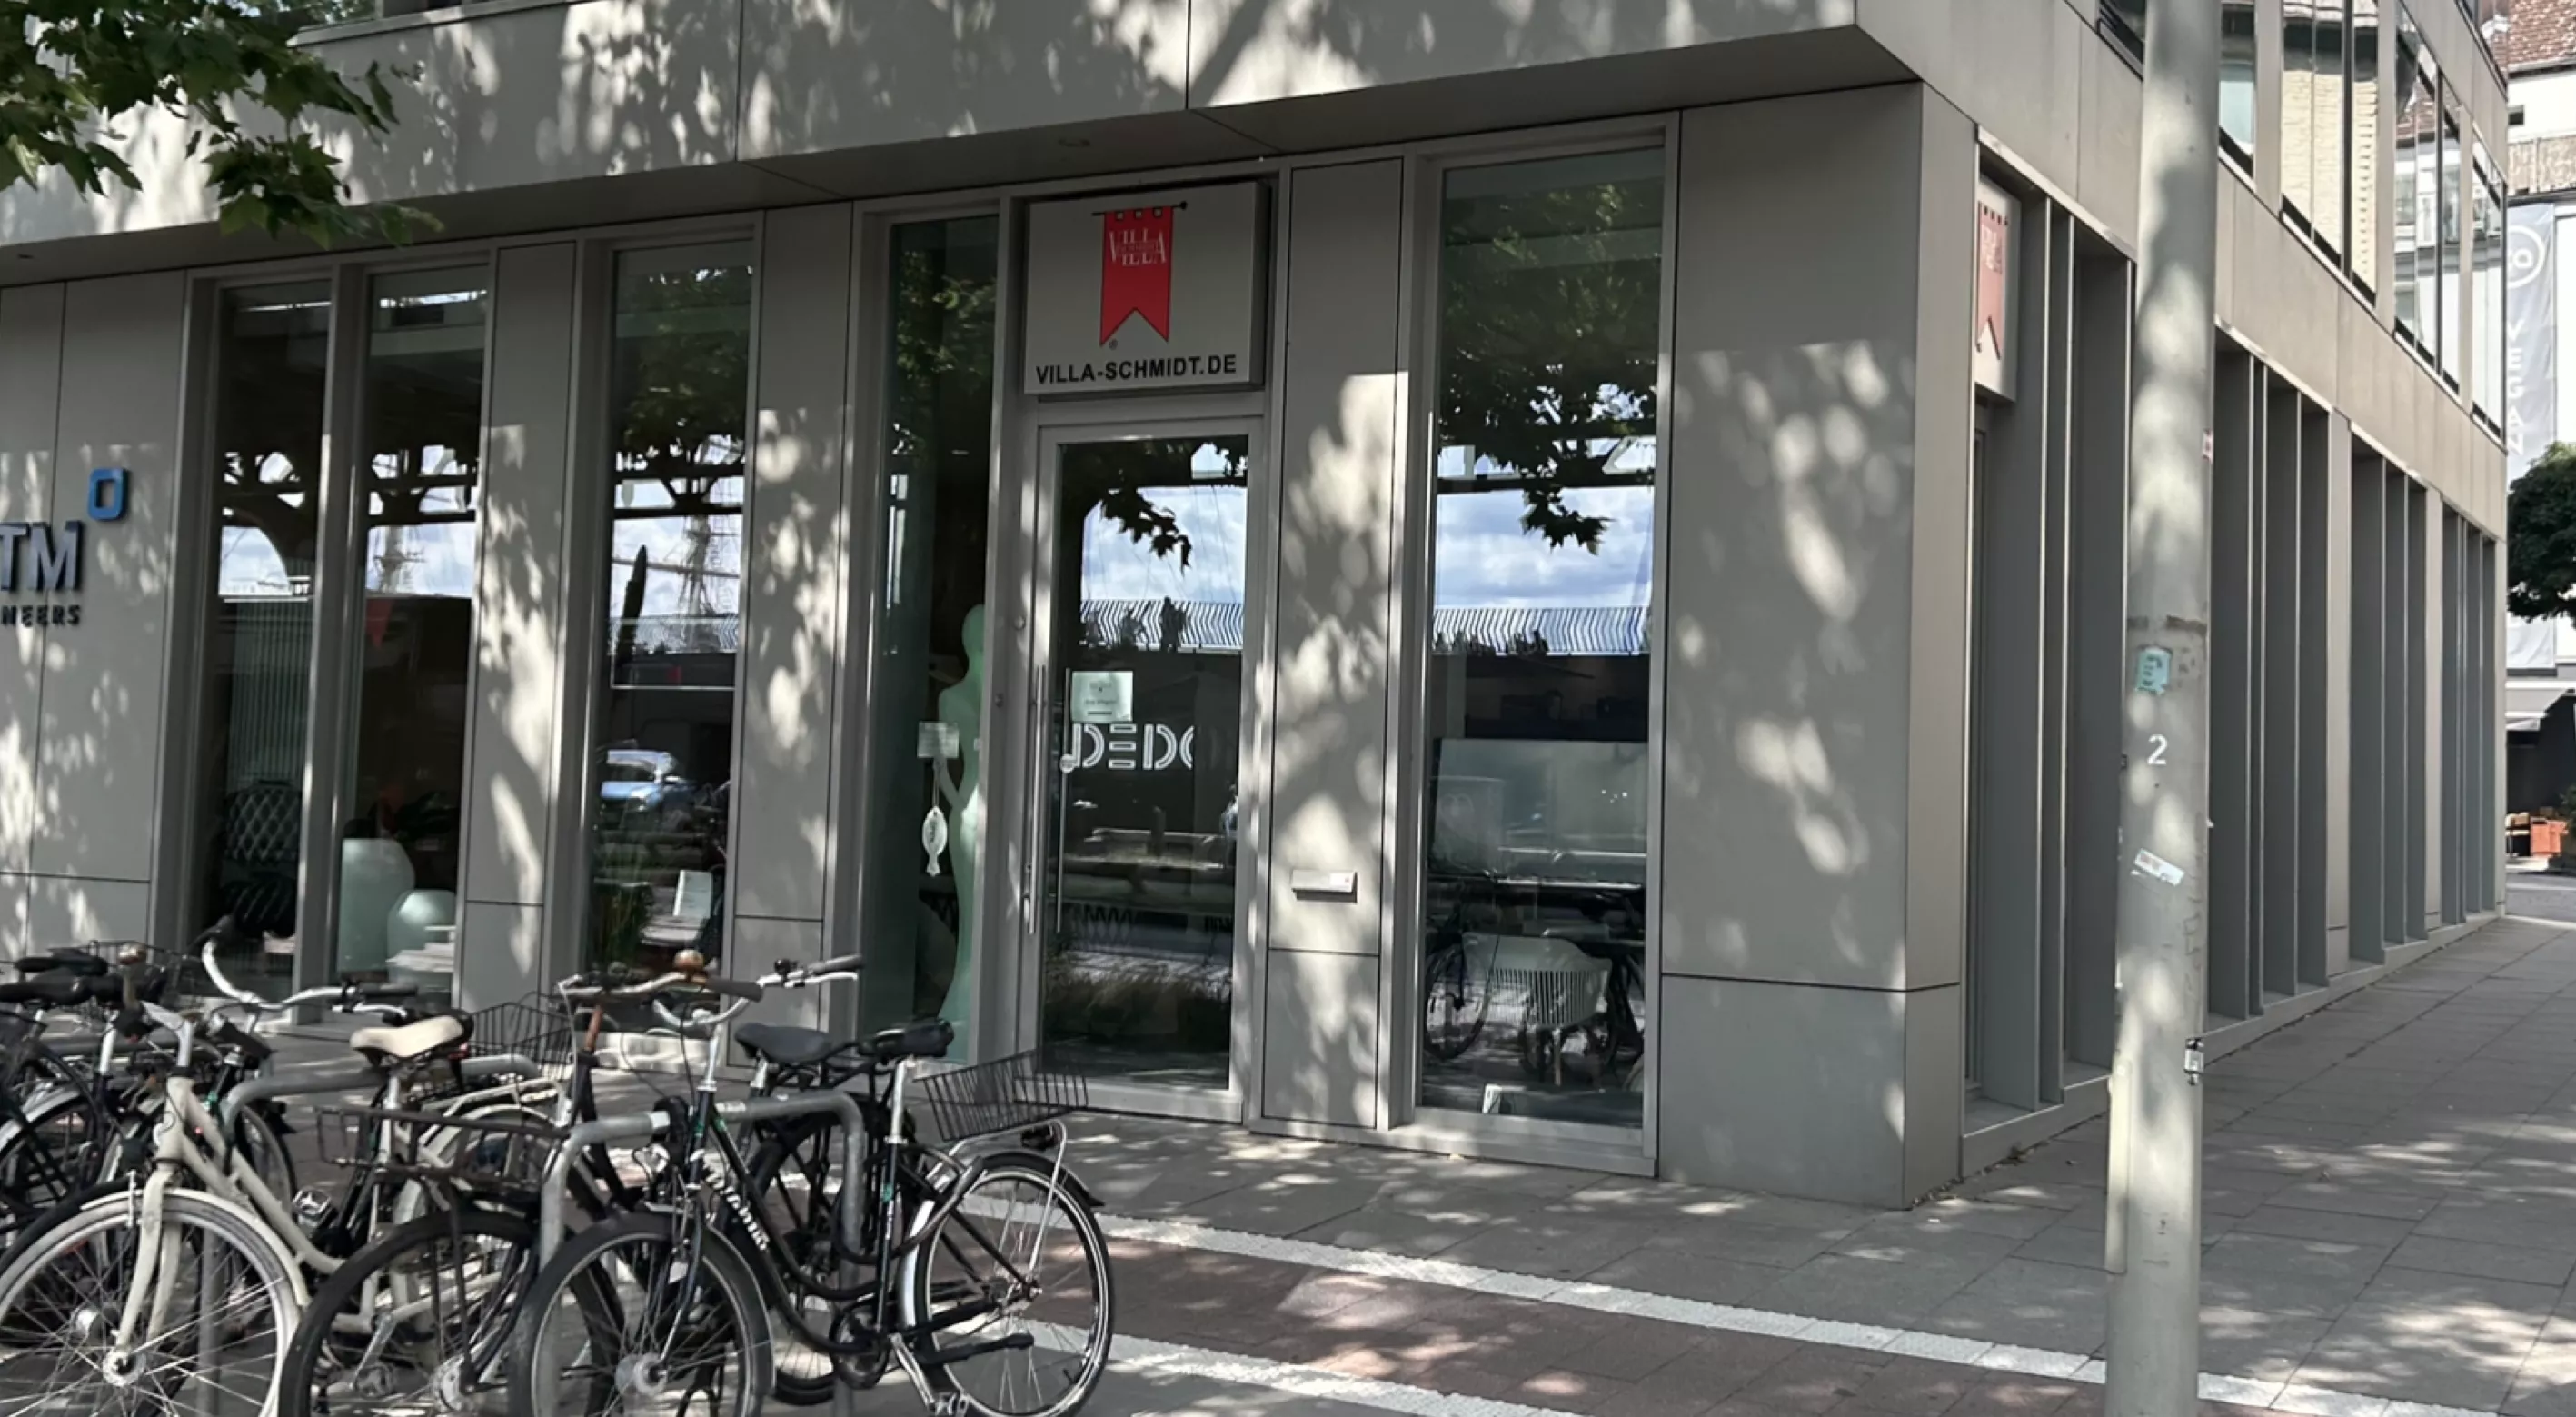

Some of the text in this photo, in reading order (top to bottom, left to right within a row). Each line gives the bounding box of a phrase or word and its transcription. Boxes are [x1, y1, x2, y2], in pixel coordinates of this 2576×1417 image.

[1109, 227, 1167, 267] VILLA
[1035, 354, 1237, 384] VILLA-SCHMIDT.DE
[2146, 733, 2168, 765] 2
